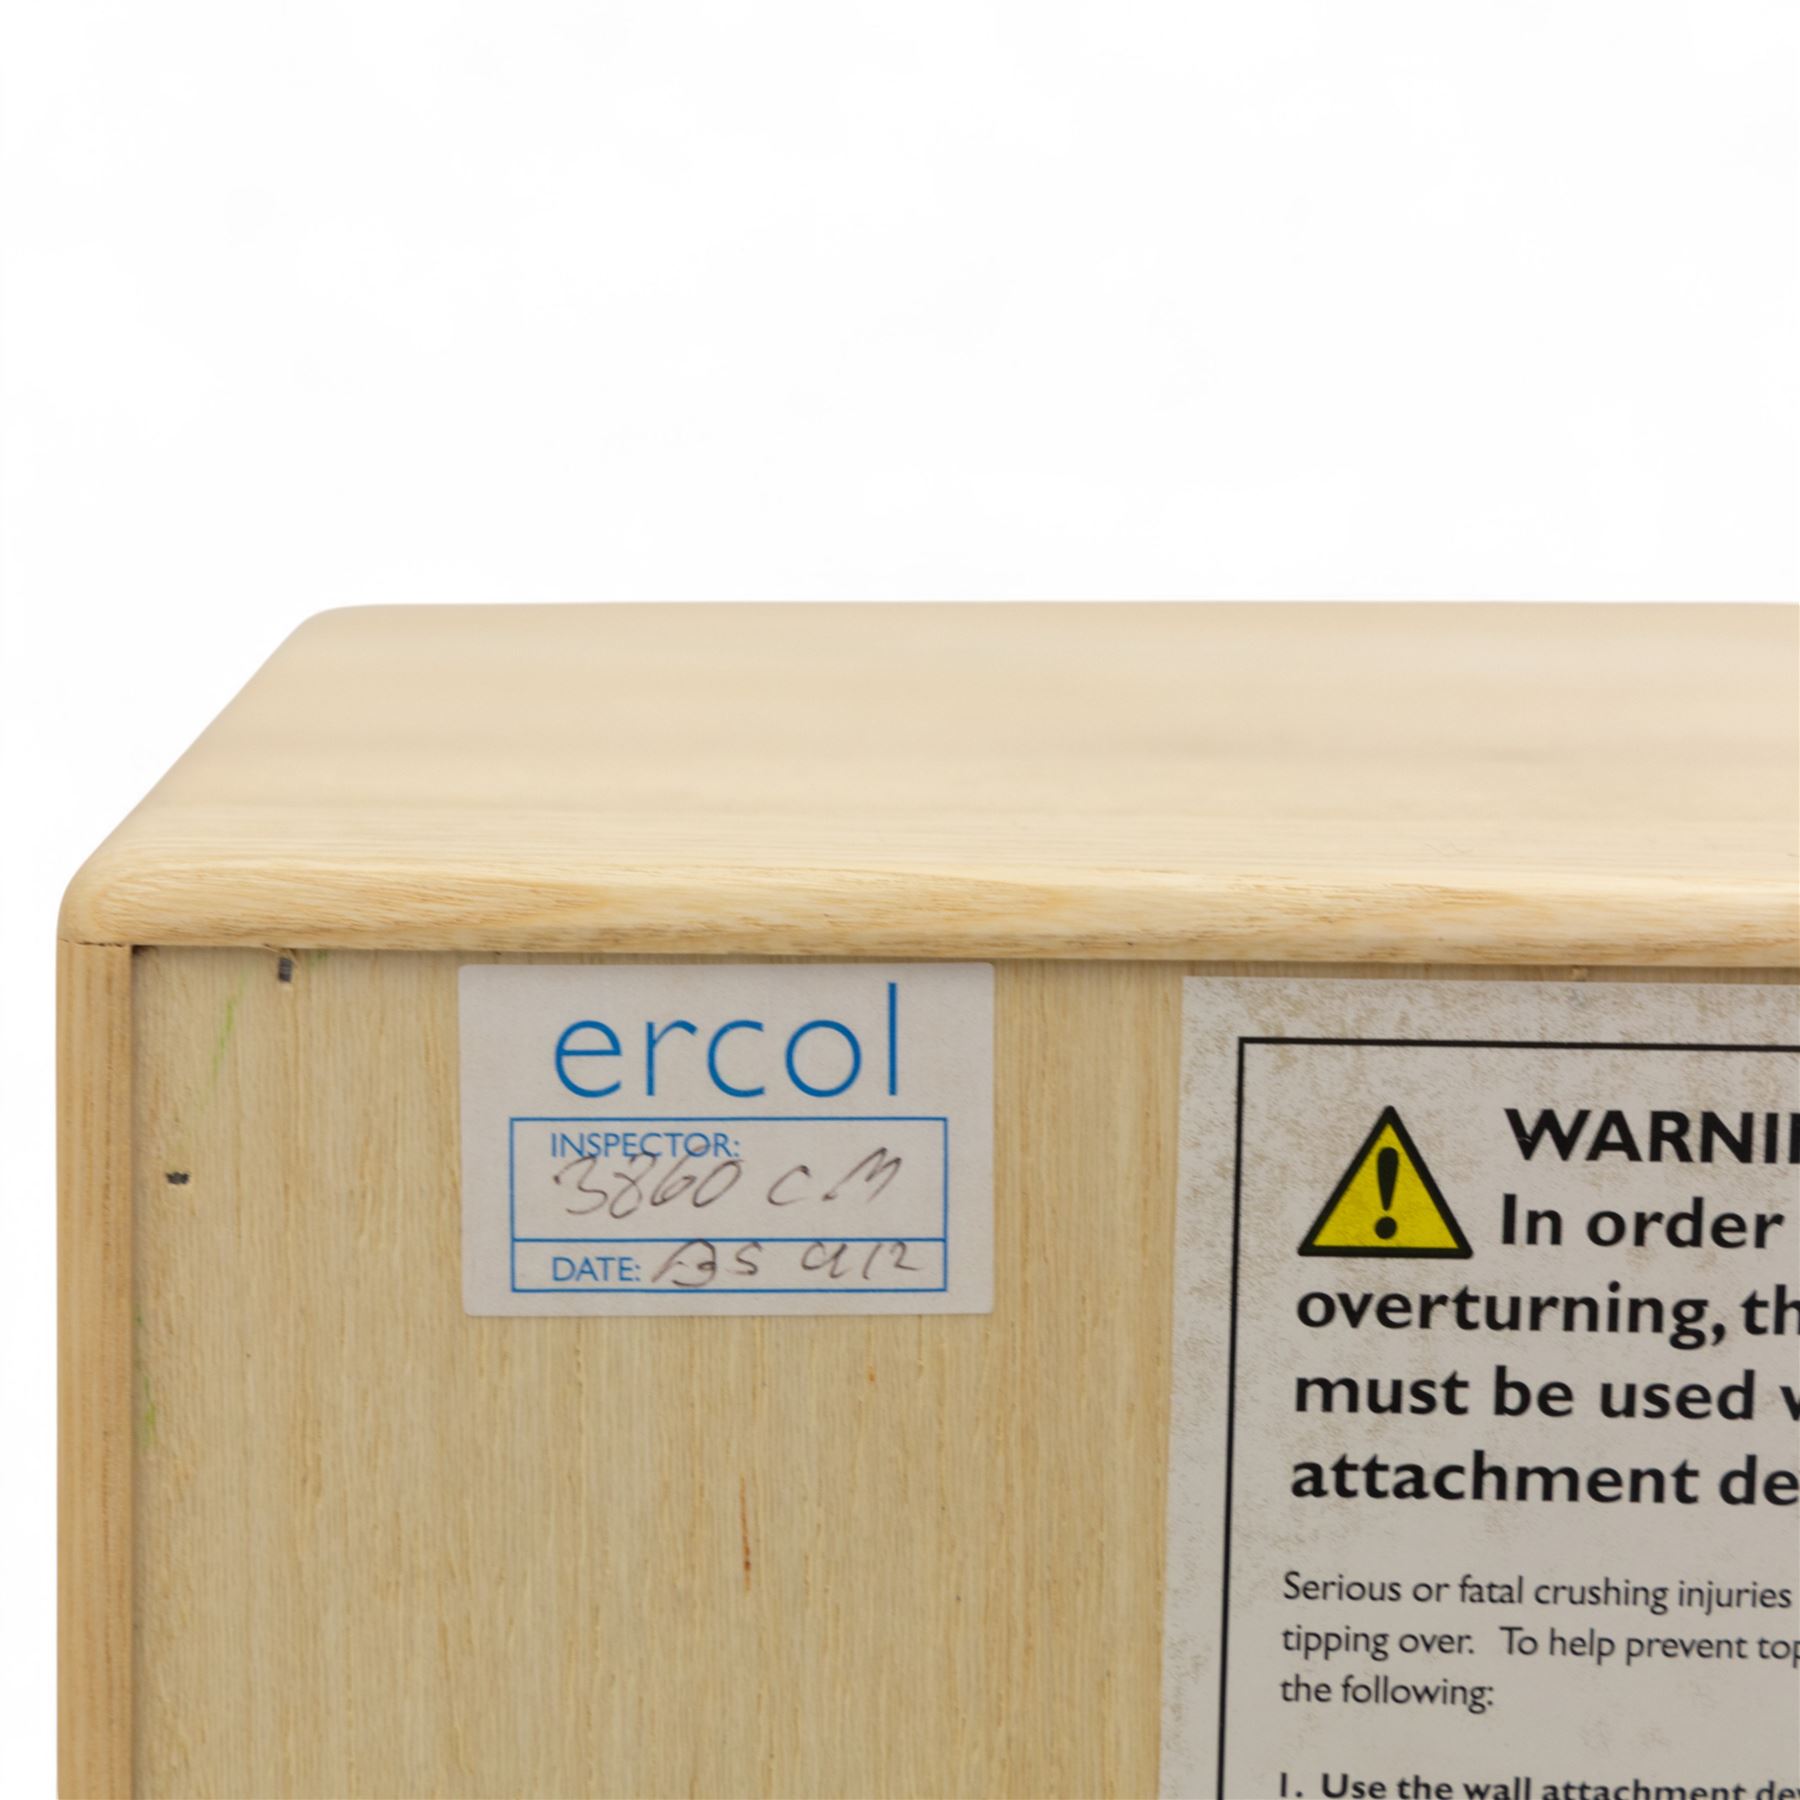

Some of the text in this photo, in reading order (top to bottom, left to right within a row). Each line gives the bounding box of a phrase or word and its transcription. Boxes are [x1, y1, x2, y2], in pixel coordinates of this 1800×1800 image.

[555, 982, 898, 1098] ercol
[550, 1132, 741, 1158] INSPECTOR:
[1504, 1108, 1800, 1164] WARNI
[1502, 1193, 1785, 1250] In order
[552, 1256, 641, 1282] DATE:
[1296, 1280, 1727, 1351] overturning,
[1295, 1370, 1470, 1416] must
[1493, 1365, 1575, 1418] be
[1600, 1369, 1756, 1421] used
[1290, 1449, 1800, 1507] attachment de
[1283, 1570, 1793, 1616] Serious or fatal crushing injuries
[1281, 1624, 1390, 1662] tipping
[1398, 1633, 1475, 1655] over.
[1499, 1625, 1539, 1656] To
[1549, 1627, 1617, 1666] help
[1626, 1637, 1749, 1667] prevent
[1280, 1673, 1495, 1715] the following:
[1280, 1772, 1303, 1798] 1.
[1321, 1773, 1388, 1800] Use
[1396, 1775, 1454, 1800] the
[1462, 1777, 1532, 1800] wall
[1541, 1778, 1748, 1800] attachment
